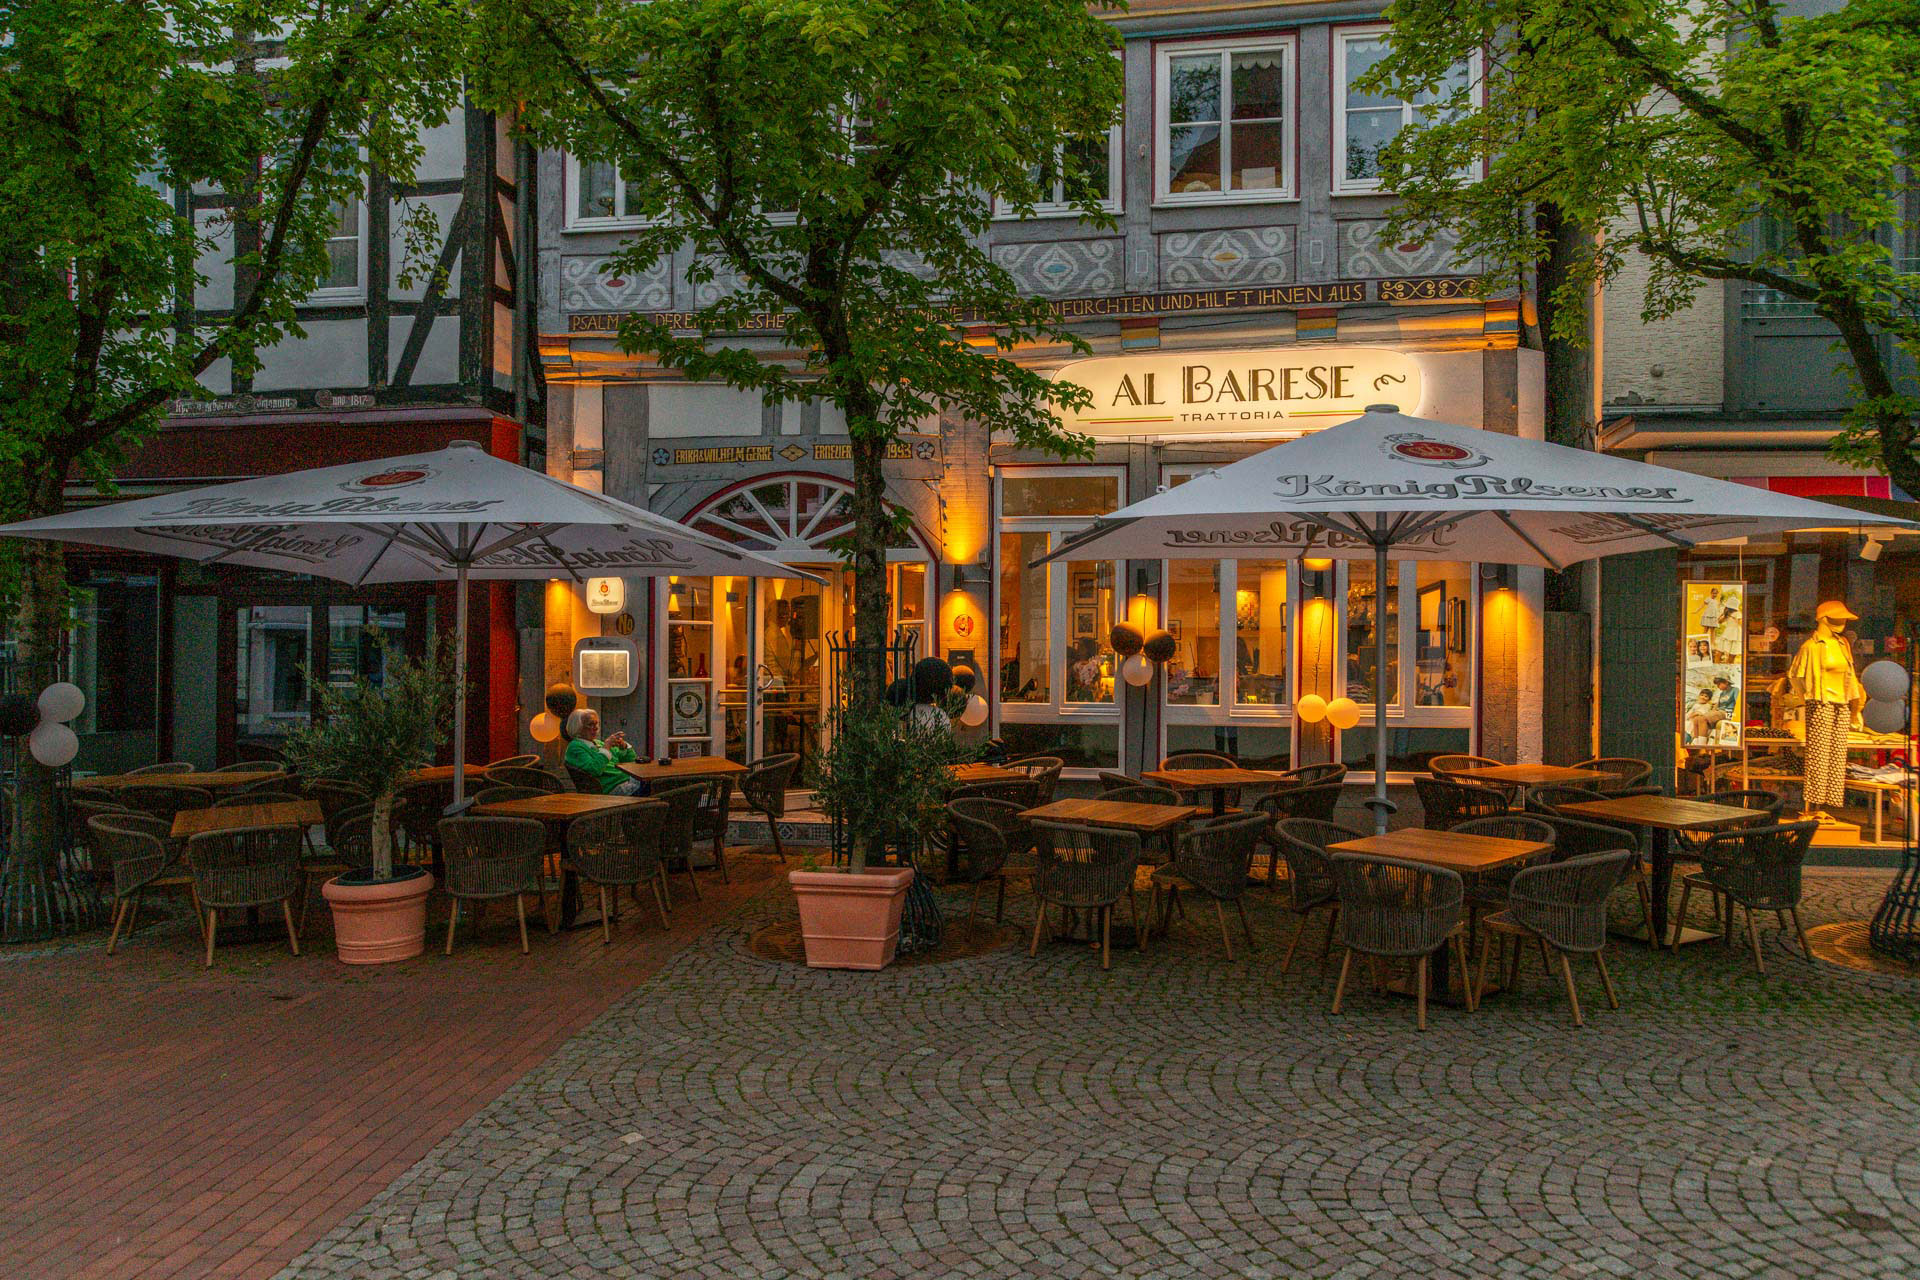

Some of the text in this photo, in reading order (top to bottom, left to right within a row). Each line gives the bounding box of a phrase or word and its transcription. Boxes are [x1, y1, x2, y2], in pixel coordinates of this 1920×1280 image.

[572, 314, 619, 331] PSALM
[1062, 296, 1154, 316] FÜRCHTEN
[1160, 295, 1192, 311] UND
[1196, 290, 1254, 309] HILFT
[1258, 286, 1322, 305] IHNEN
[1328, 284, 1363, 302] AUS
[1111, 365, 1354, 407] AL BARESE
[1180, 410, 1284, 423] TRATTORIA
[746, 446, 772, 462] GERKE
[815, 444, 853, 460] ERNEUER
[1271, 473, 1679, 500] König Pilsener
